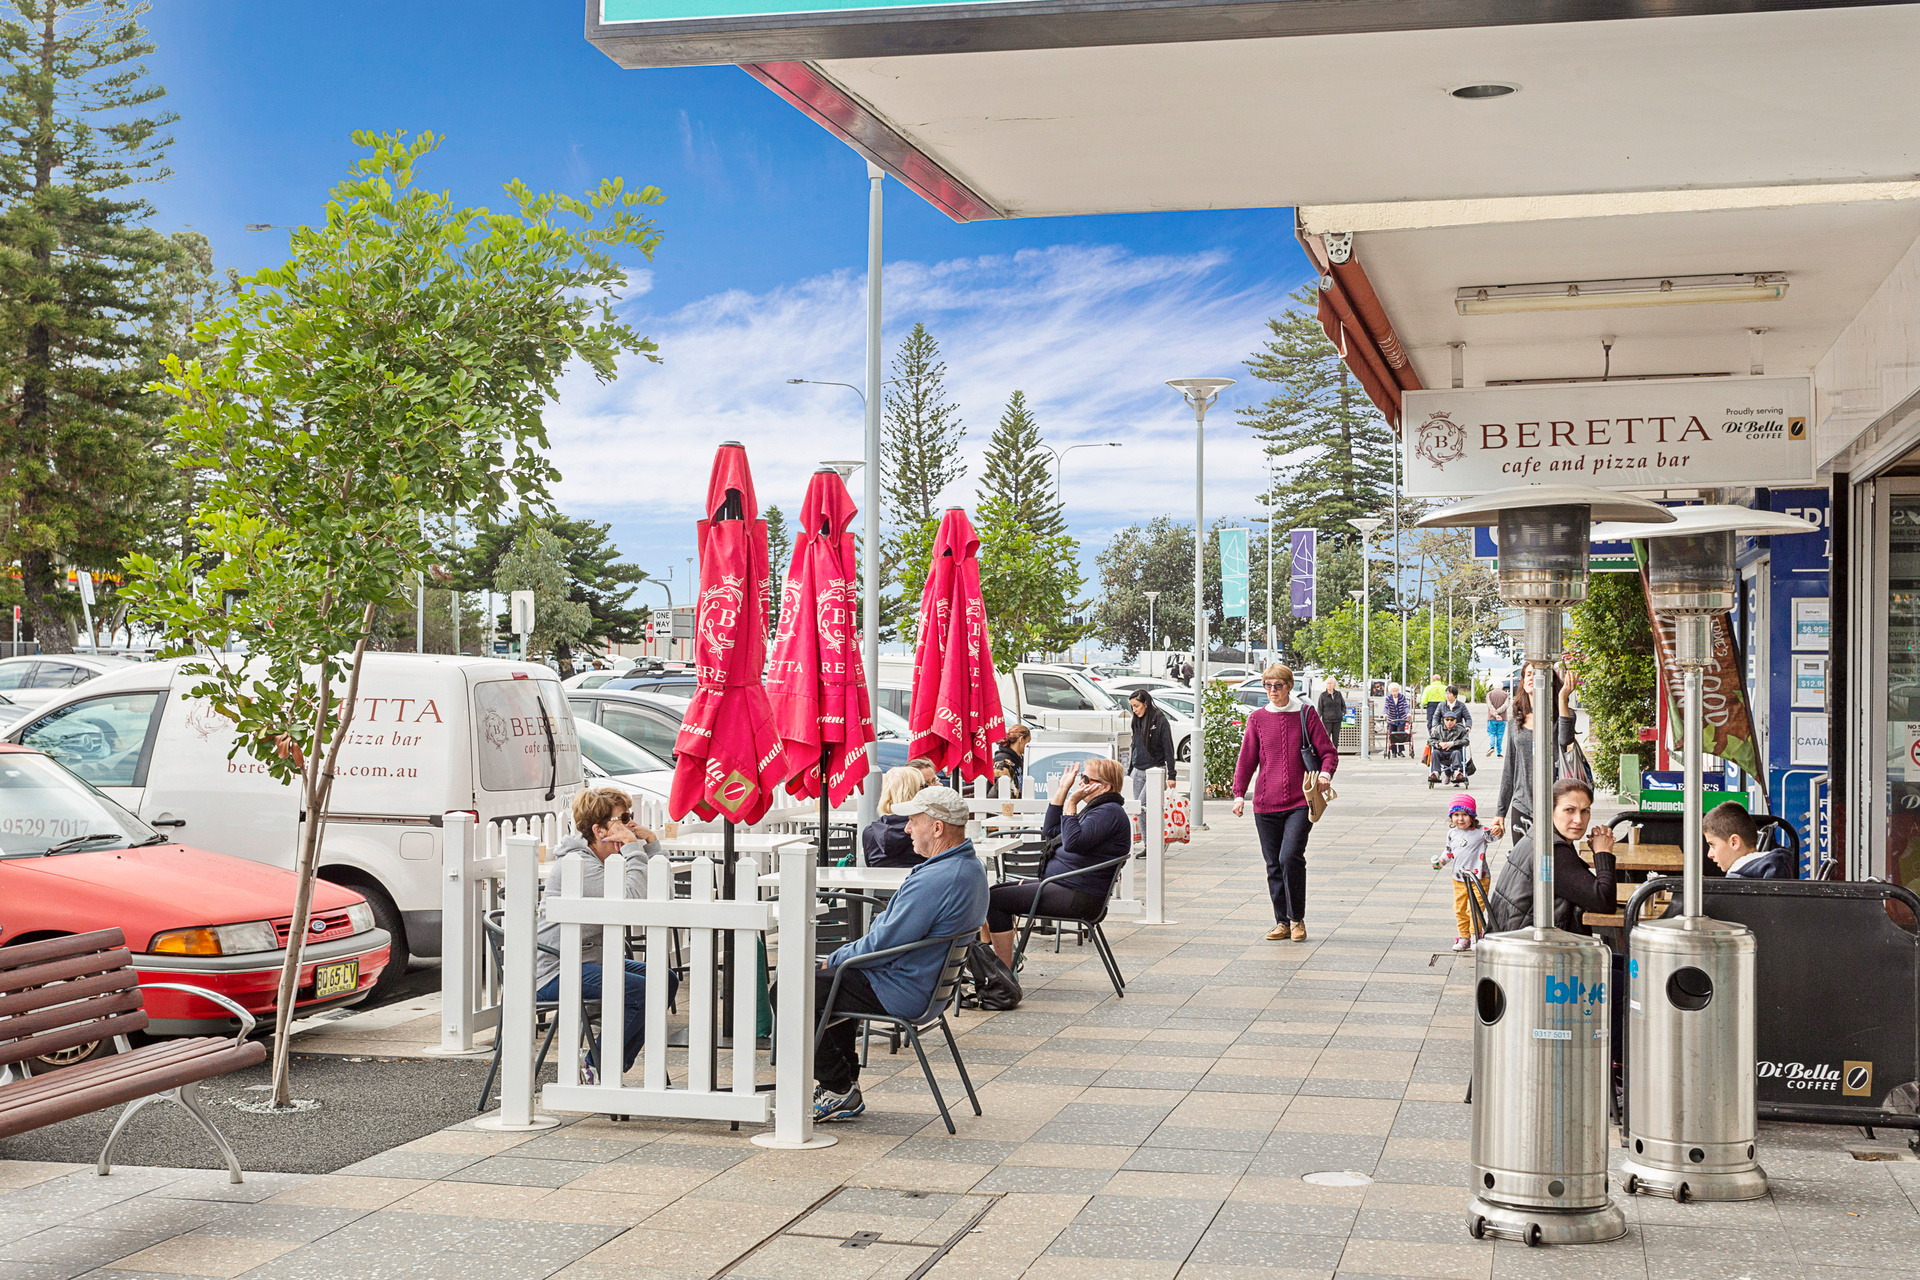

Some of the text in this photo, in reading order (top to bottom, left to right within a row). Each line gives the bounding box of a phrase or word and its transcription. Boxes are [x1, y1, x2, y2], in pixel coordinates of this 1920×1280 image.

[1726, 407, 1784, 416] Proudly serving
[1479, 415, 1713, 450] BERETTA
[1746, 432, 1783, 440] COFFEE
[1502, 451, 1690, 478] cafe and pizza bar
[768, 660, 803, 673] ETTA
[392, 731, 421, 746] bar
[1797, 737, 1829, 746] CATAL
[524, 741, 541, 757] cafe
[1641, 799, 1685, 812] Acupunctu
[3, 819, 89, 838] 9529 7017
[1787, 1080, 1837, 1091] COFFEE
